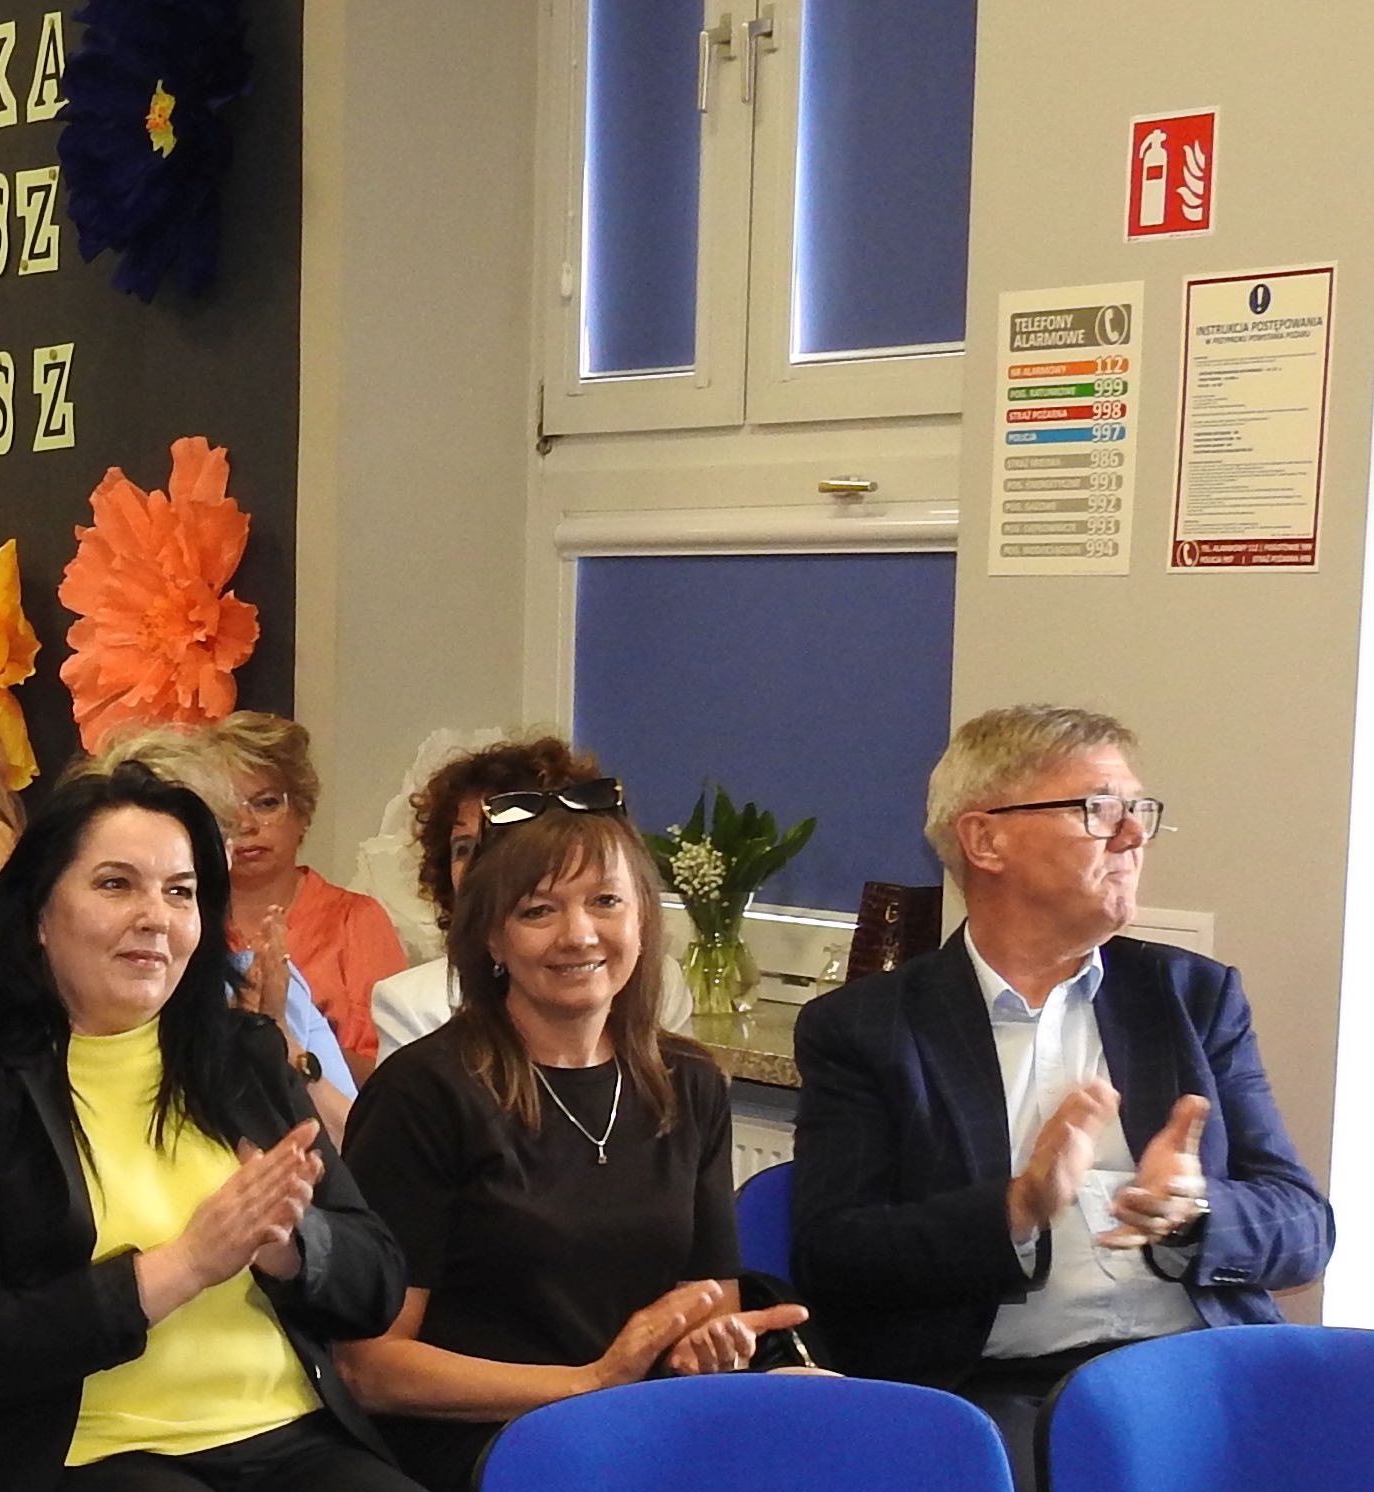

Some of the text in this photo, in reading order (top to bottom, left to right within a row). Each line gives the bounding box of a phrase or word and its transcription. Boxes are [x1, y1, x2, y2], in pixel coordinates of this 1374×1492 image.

[1014, 314, 1073, 332] TELEFONY
[1014, 329, 1085, 348] ALARMOWE
[1095, 357, 1124, 374] 112
[1094, 379, 1124, 397] 999
[1092, 402, 1122, 419] 998
[1091, 424, 1121, 442] 997
[1090, 451, 1120, 468] 986
[1089, 473, 1118, 491] 991
[1087, 495, 1117, 513] 992
[1087, 517, 1116, 535] 993
[1085, 539, 1114, 557] 994
